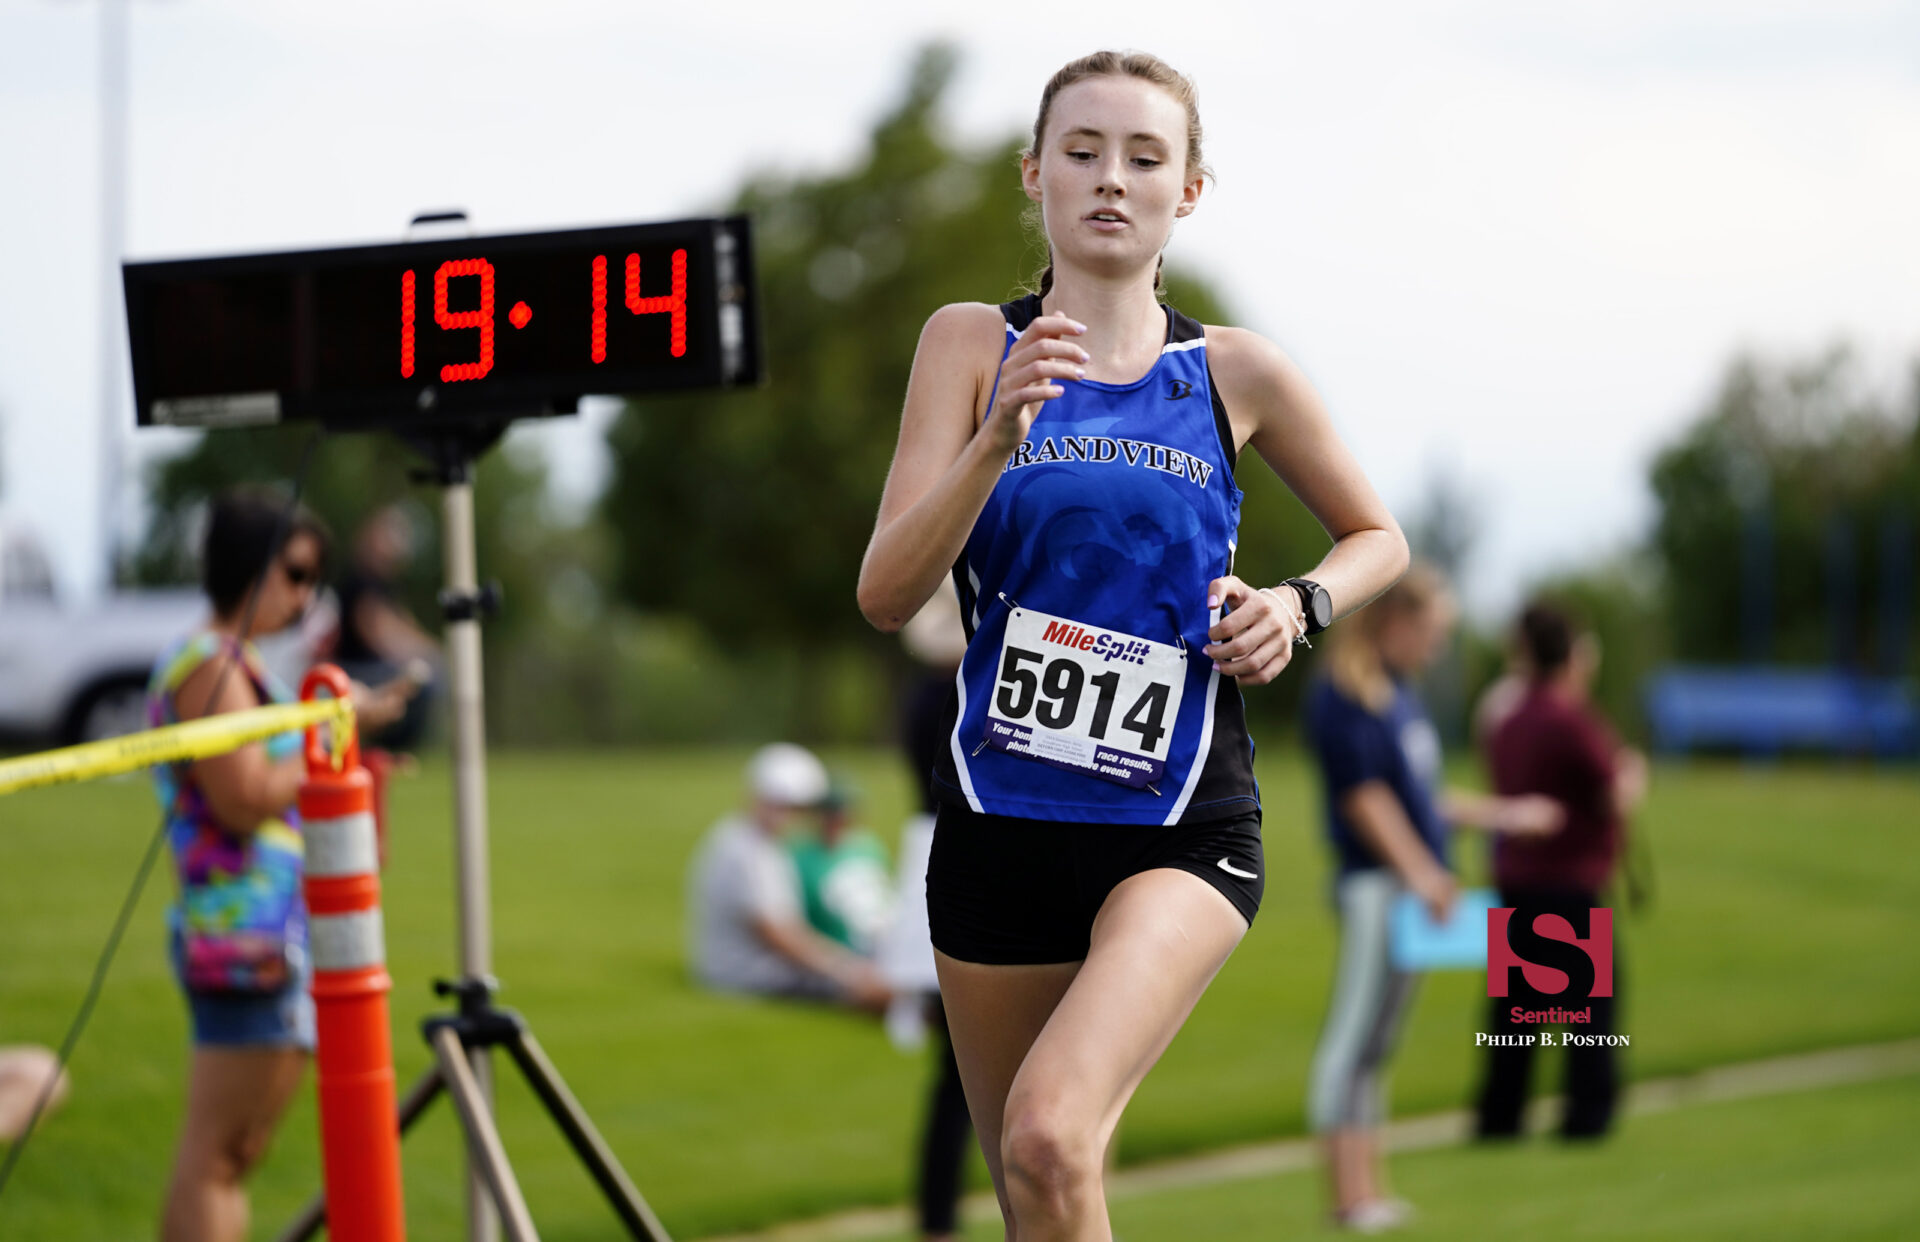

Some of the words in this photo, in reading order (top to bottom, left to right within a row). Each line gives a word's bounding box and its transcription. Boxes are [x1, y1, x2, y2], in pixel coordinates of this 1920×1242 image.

[1002, 436, 1213, 488] RANDVIEW
[1042, 620, 1150, 665] MileSplit
[996, 645, 1170, 753] 5914
[992, 722, 1013, 736] Your
[1013, 728, 1032, 741] hom
[1096, 751, 1119, 763] race
[1119, 756, 1153, 774] results,
[1100, 764, 1131, 779] events
